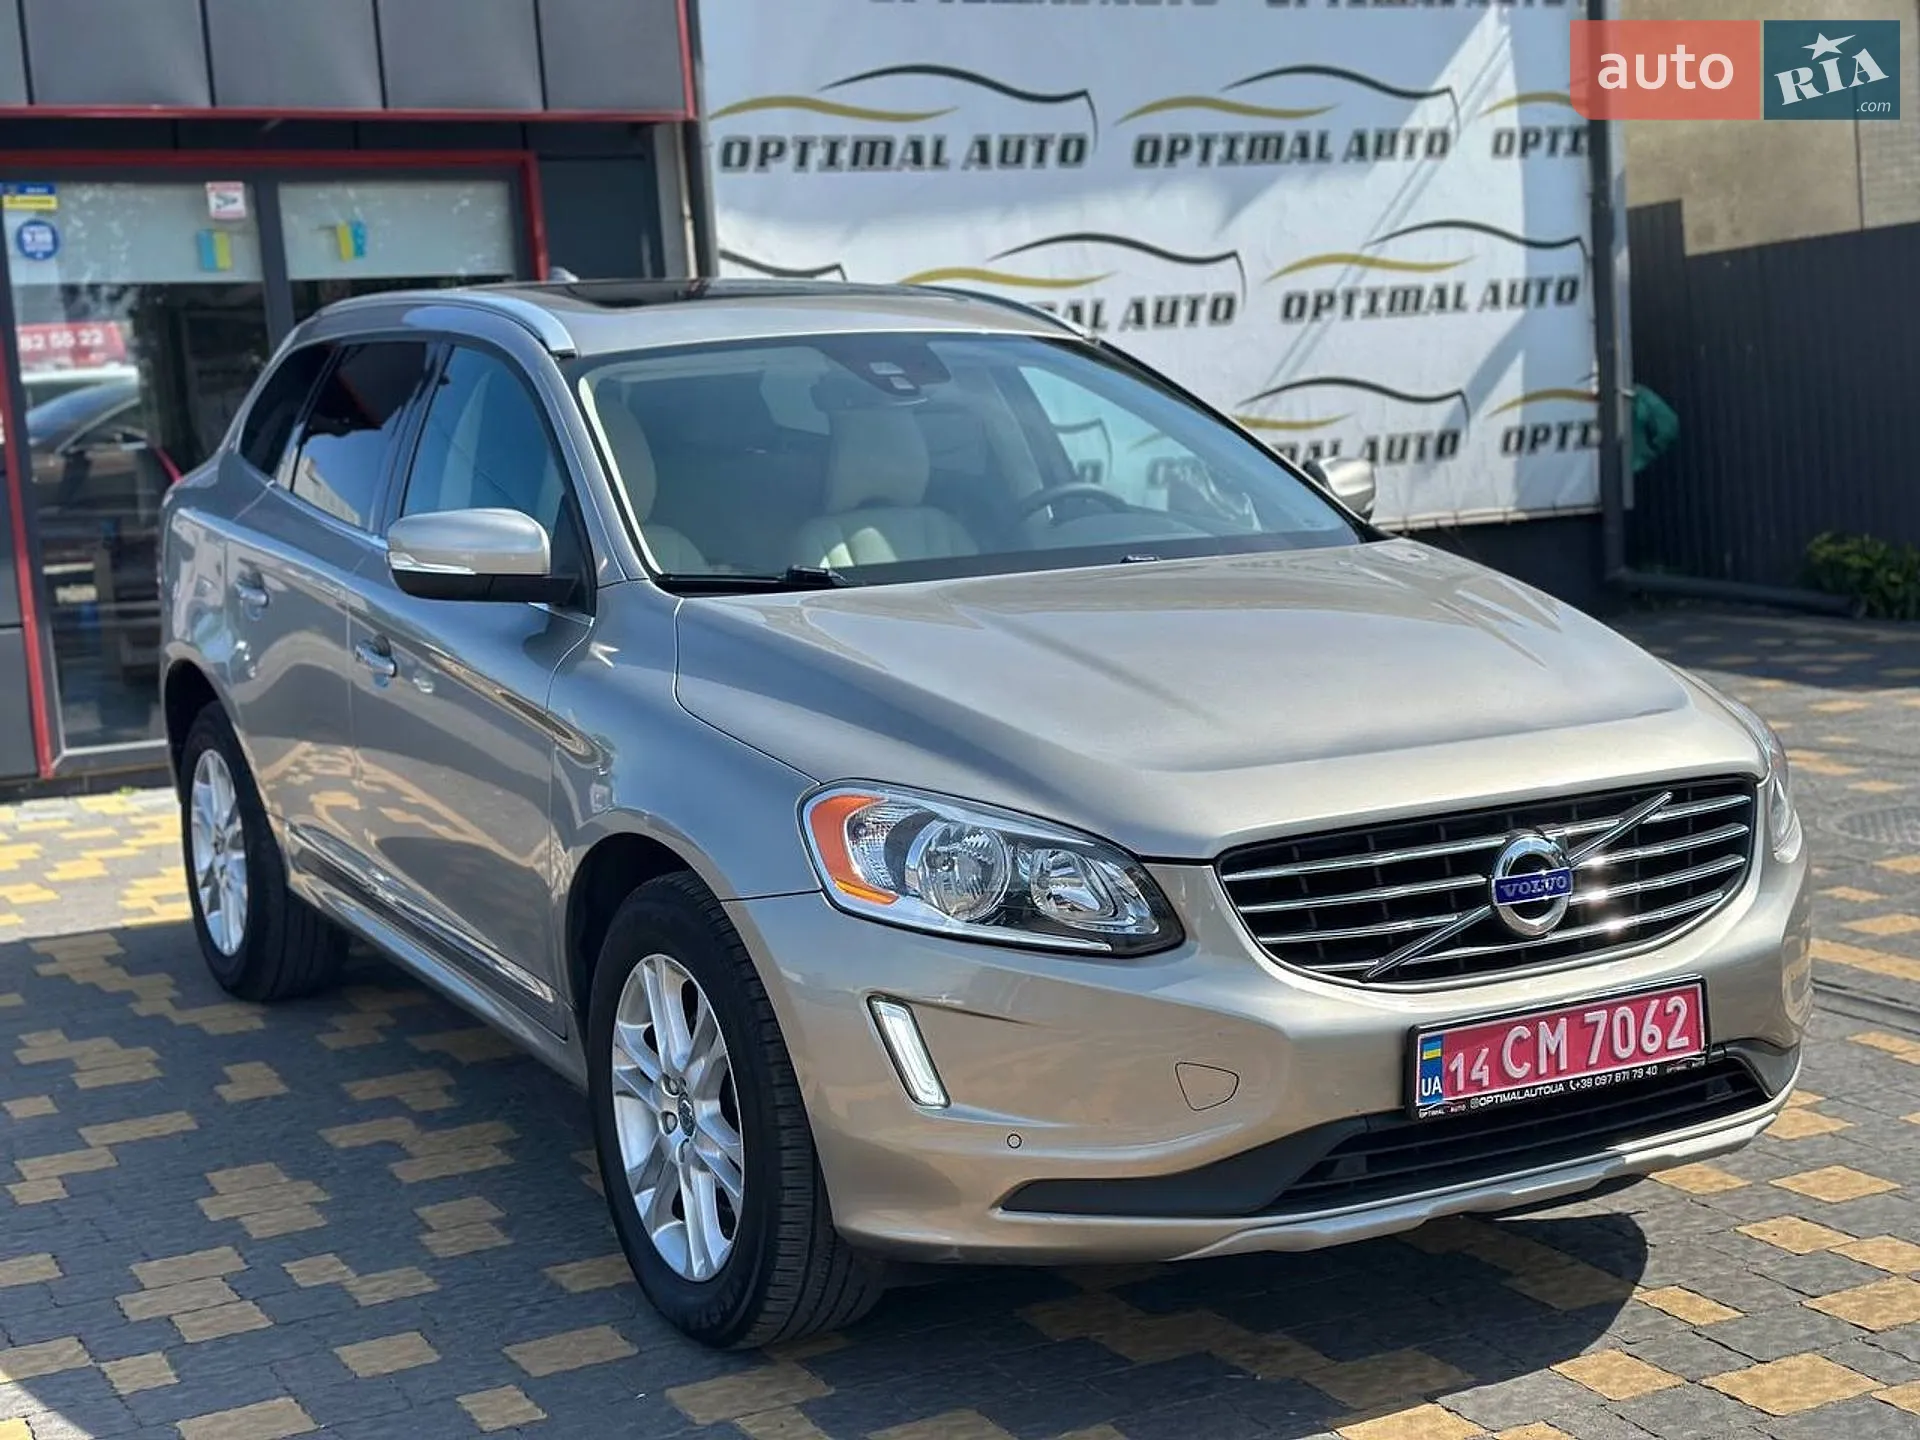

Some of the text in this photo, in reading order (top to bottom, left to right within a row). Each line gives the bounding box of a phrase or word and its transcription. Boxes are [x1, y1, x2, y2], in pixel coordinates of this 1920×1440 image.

[719, 133, 1090, 173] OPTIMAL AUTO
[1133, 127, 1449, 168] OPTIMAL AUTO
[1118, 291, 1238, 332] AUTO
[1281, 275, 1579, 323] OPTIMAL AUTO
[1358, 428, 1461, 467] AUTO
[1500, 876, 1567, 897] VOLVO
[1449, 1047, 1489, 1092] 14
[1584, 996, 1689, 1065] 7062
[1421, 1075, 1443, 1096] UA
